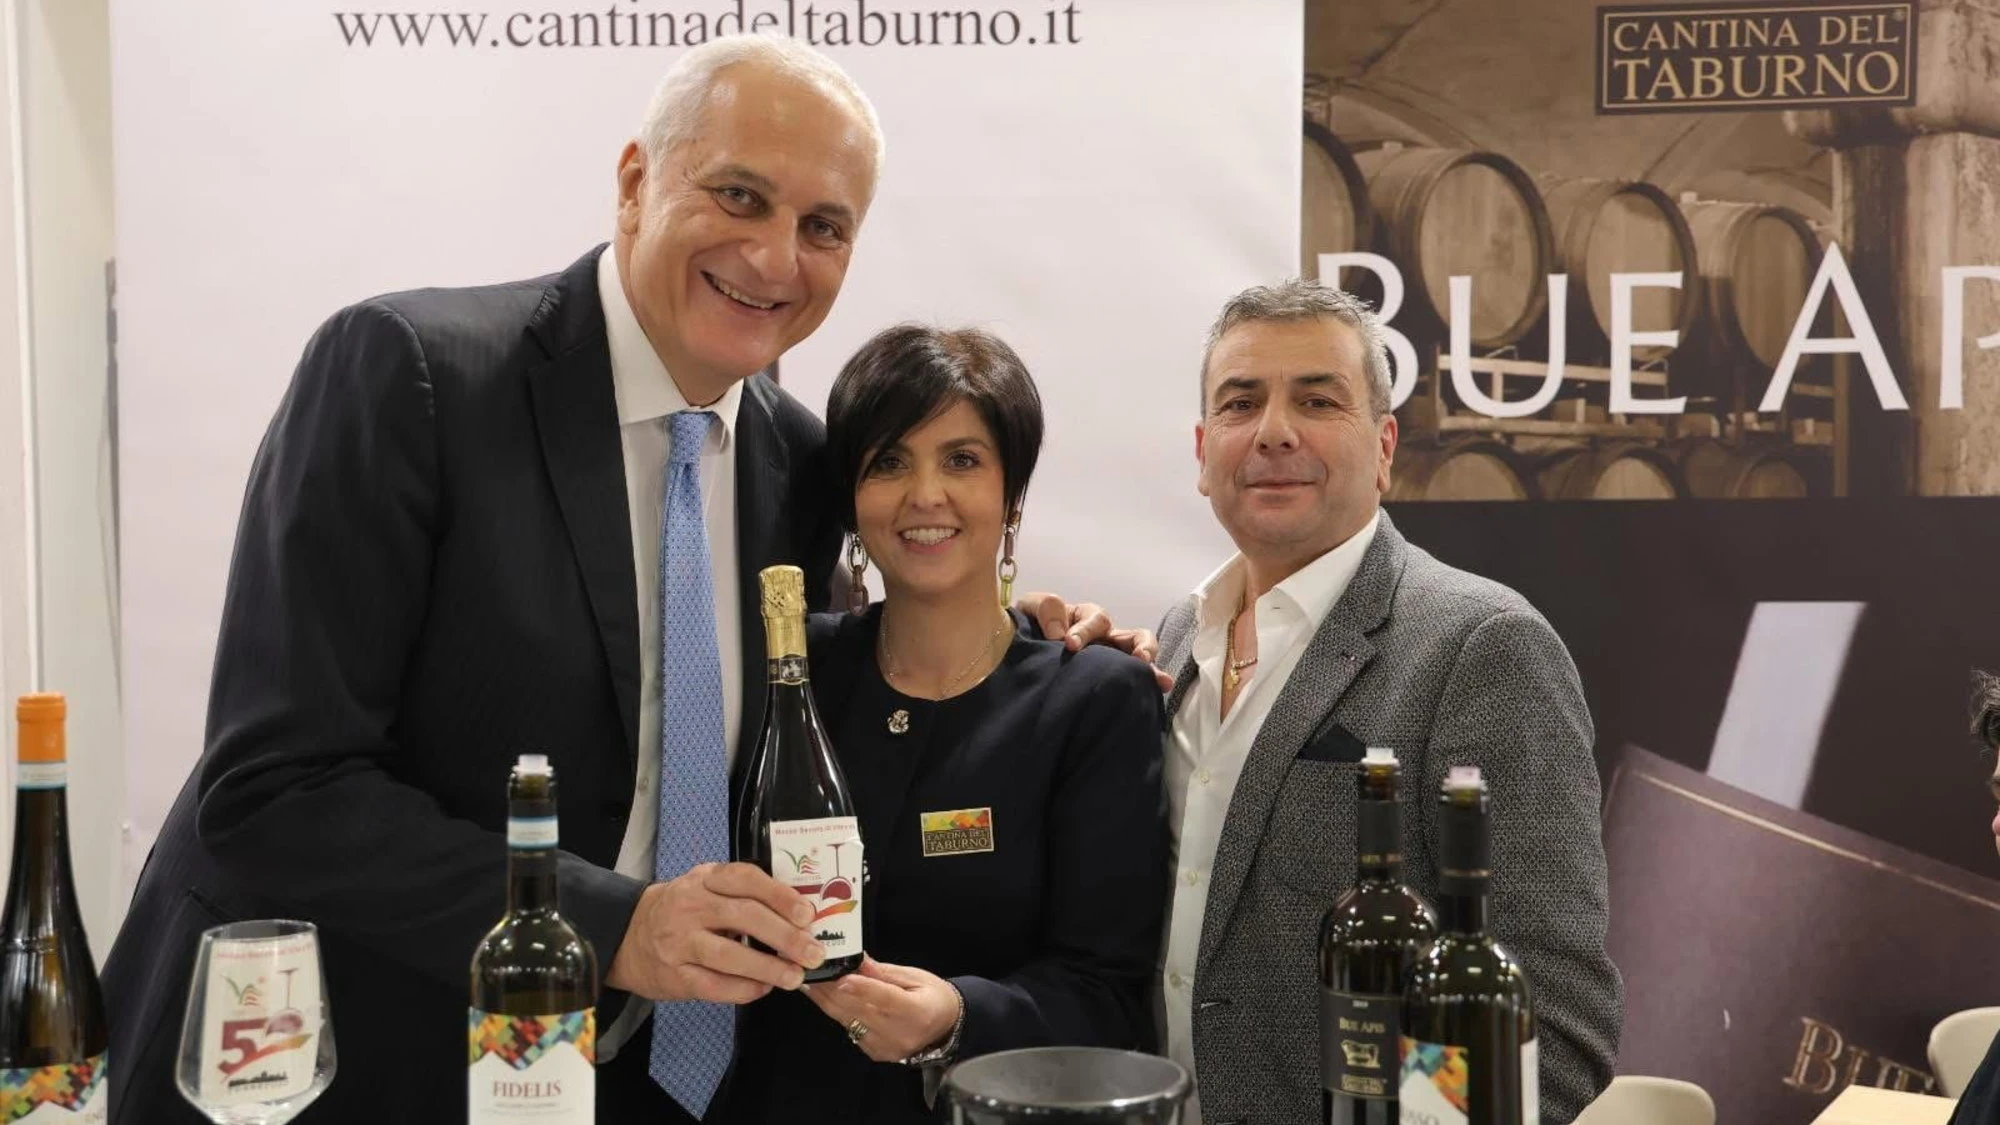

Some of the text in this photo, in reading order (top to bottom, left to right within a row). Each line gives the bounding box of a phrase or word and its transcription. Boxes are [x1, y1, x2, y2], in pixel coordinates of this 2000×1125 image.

[334, 0, 1082, 47] www.cantinadeltaburno.it
[1613, 14, 1899, 51] CANTINA DEL
[1613, 51, 1899, 100] TABURNO
[1317, 252, 1688, 418] BUE
[930, 836, 989, 851] TABURNO
[492, 1079, 562, 1098] FIDELIS
